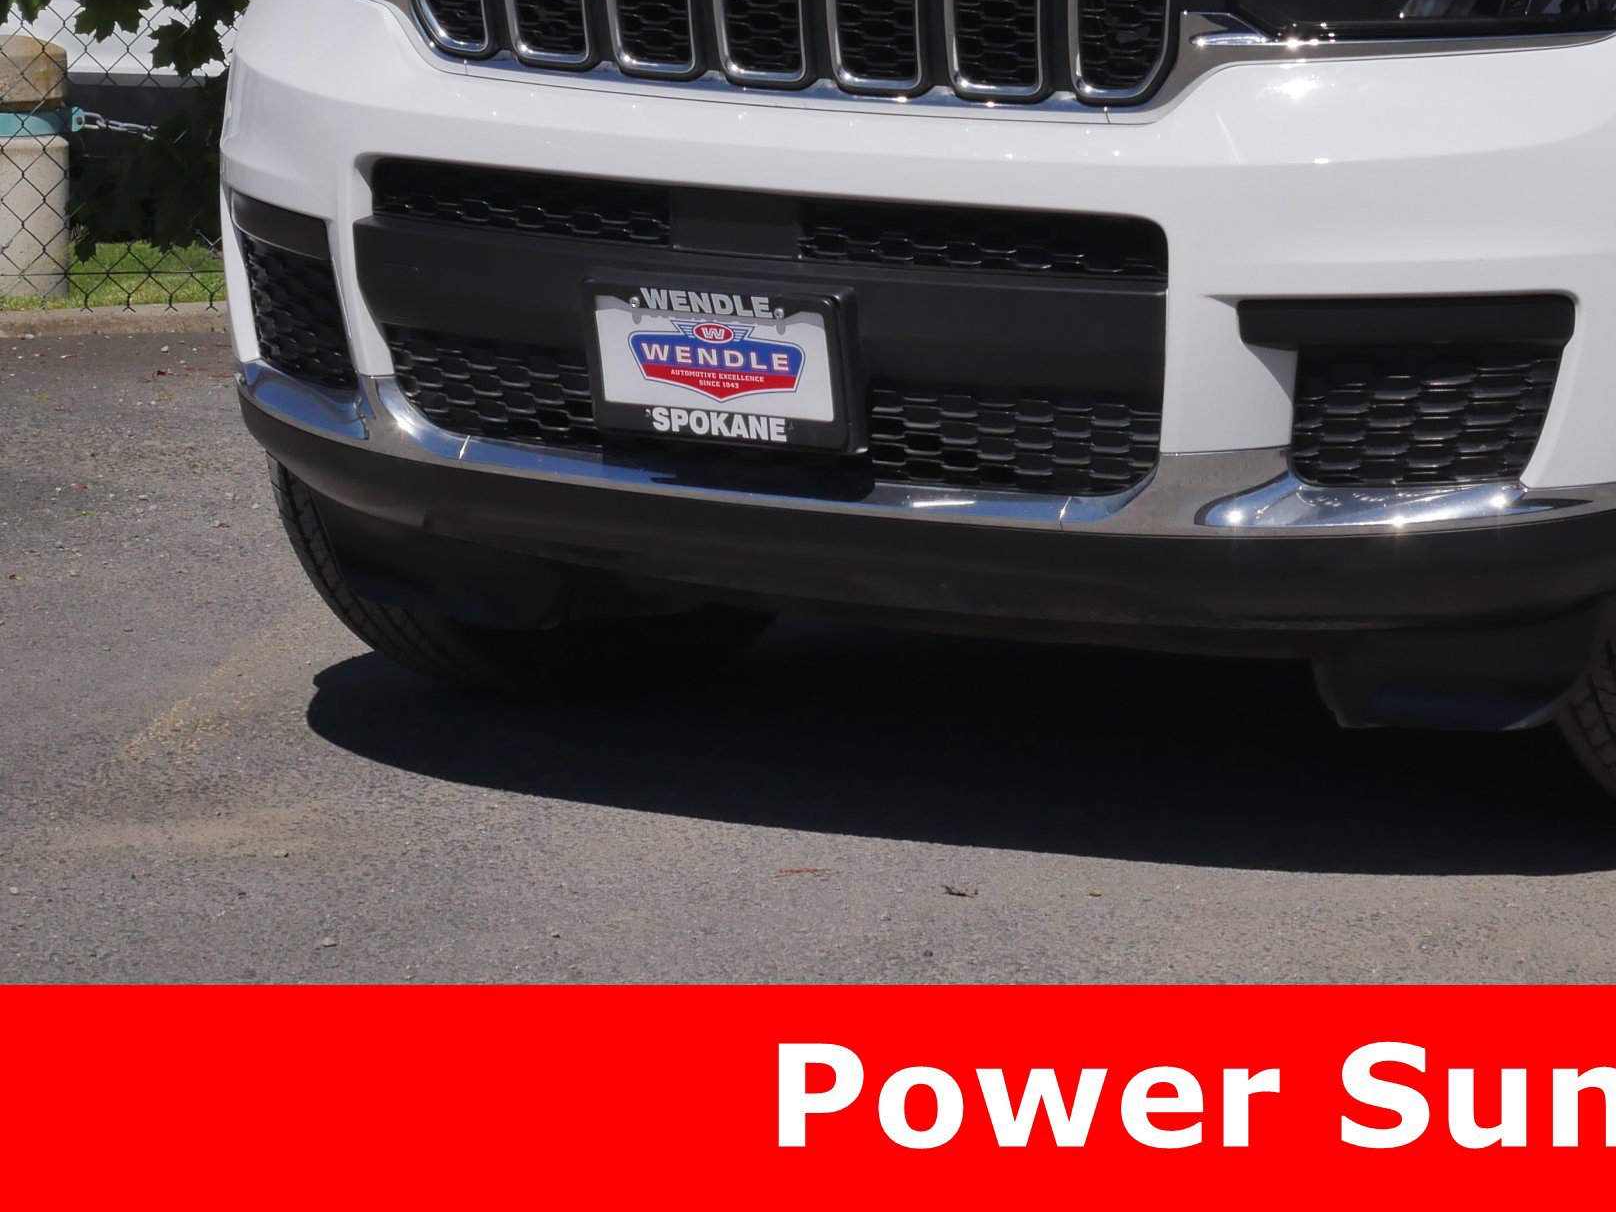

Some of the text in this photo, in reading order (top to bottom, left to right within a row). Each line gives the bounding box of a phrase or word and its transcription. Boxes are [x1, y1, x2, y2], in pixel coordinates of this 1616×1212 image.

[640, 287, 774, 319] WENDLE
[641, 342, 790, 371] WENDLE
[670, 368, 765, 383] AUTOMOTIVE EXCELLENCE
[698, 379, 721, 388] SINCE
[652, 406, 788, 443] SPOKANE
